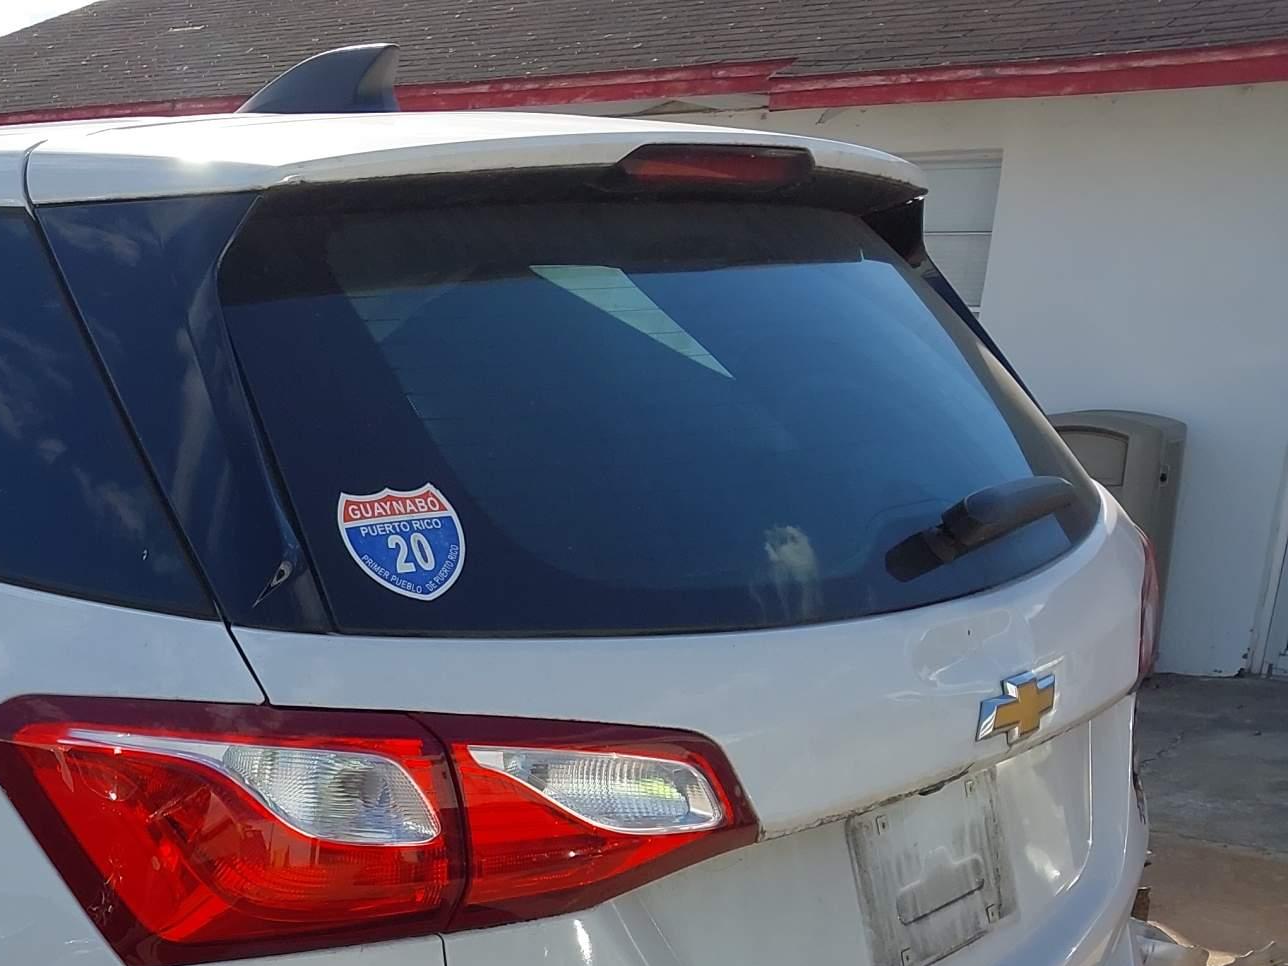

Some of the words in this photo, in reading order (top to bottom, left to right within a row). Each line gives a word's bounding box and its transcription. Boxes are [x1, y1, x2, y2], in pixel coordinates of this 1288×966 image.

[348, 497, 440, 519] GUAYNABO
[360, 522, 410, 537] PUERTO
[412, 518, 442, 531] RICO
[361, 554, 390, 579] PRIMER
[390, 574, 423, 594] PUEBLO
[426, 581, 438, 592] DE
[434, 560, 454, 585] PUERTO
[447, 544, 460, 562] RICO
[387, 532, 436, 574] 20
